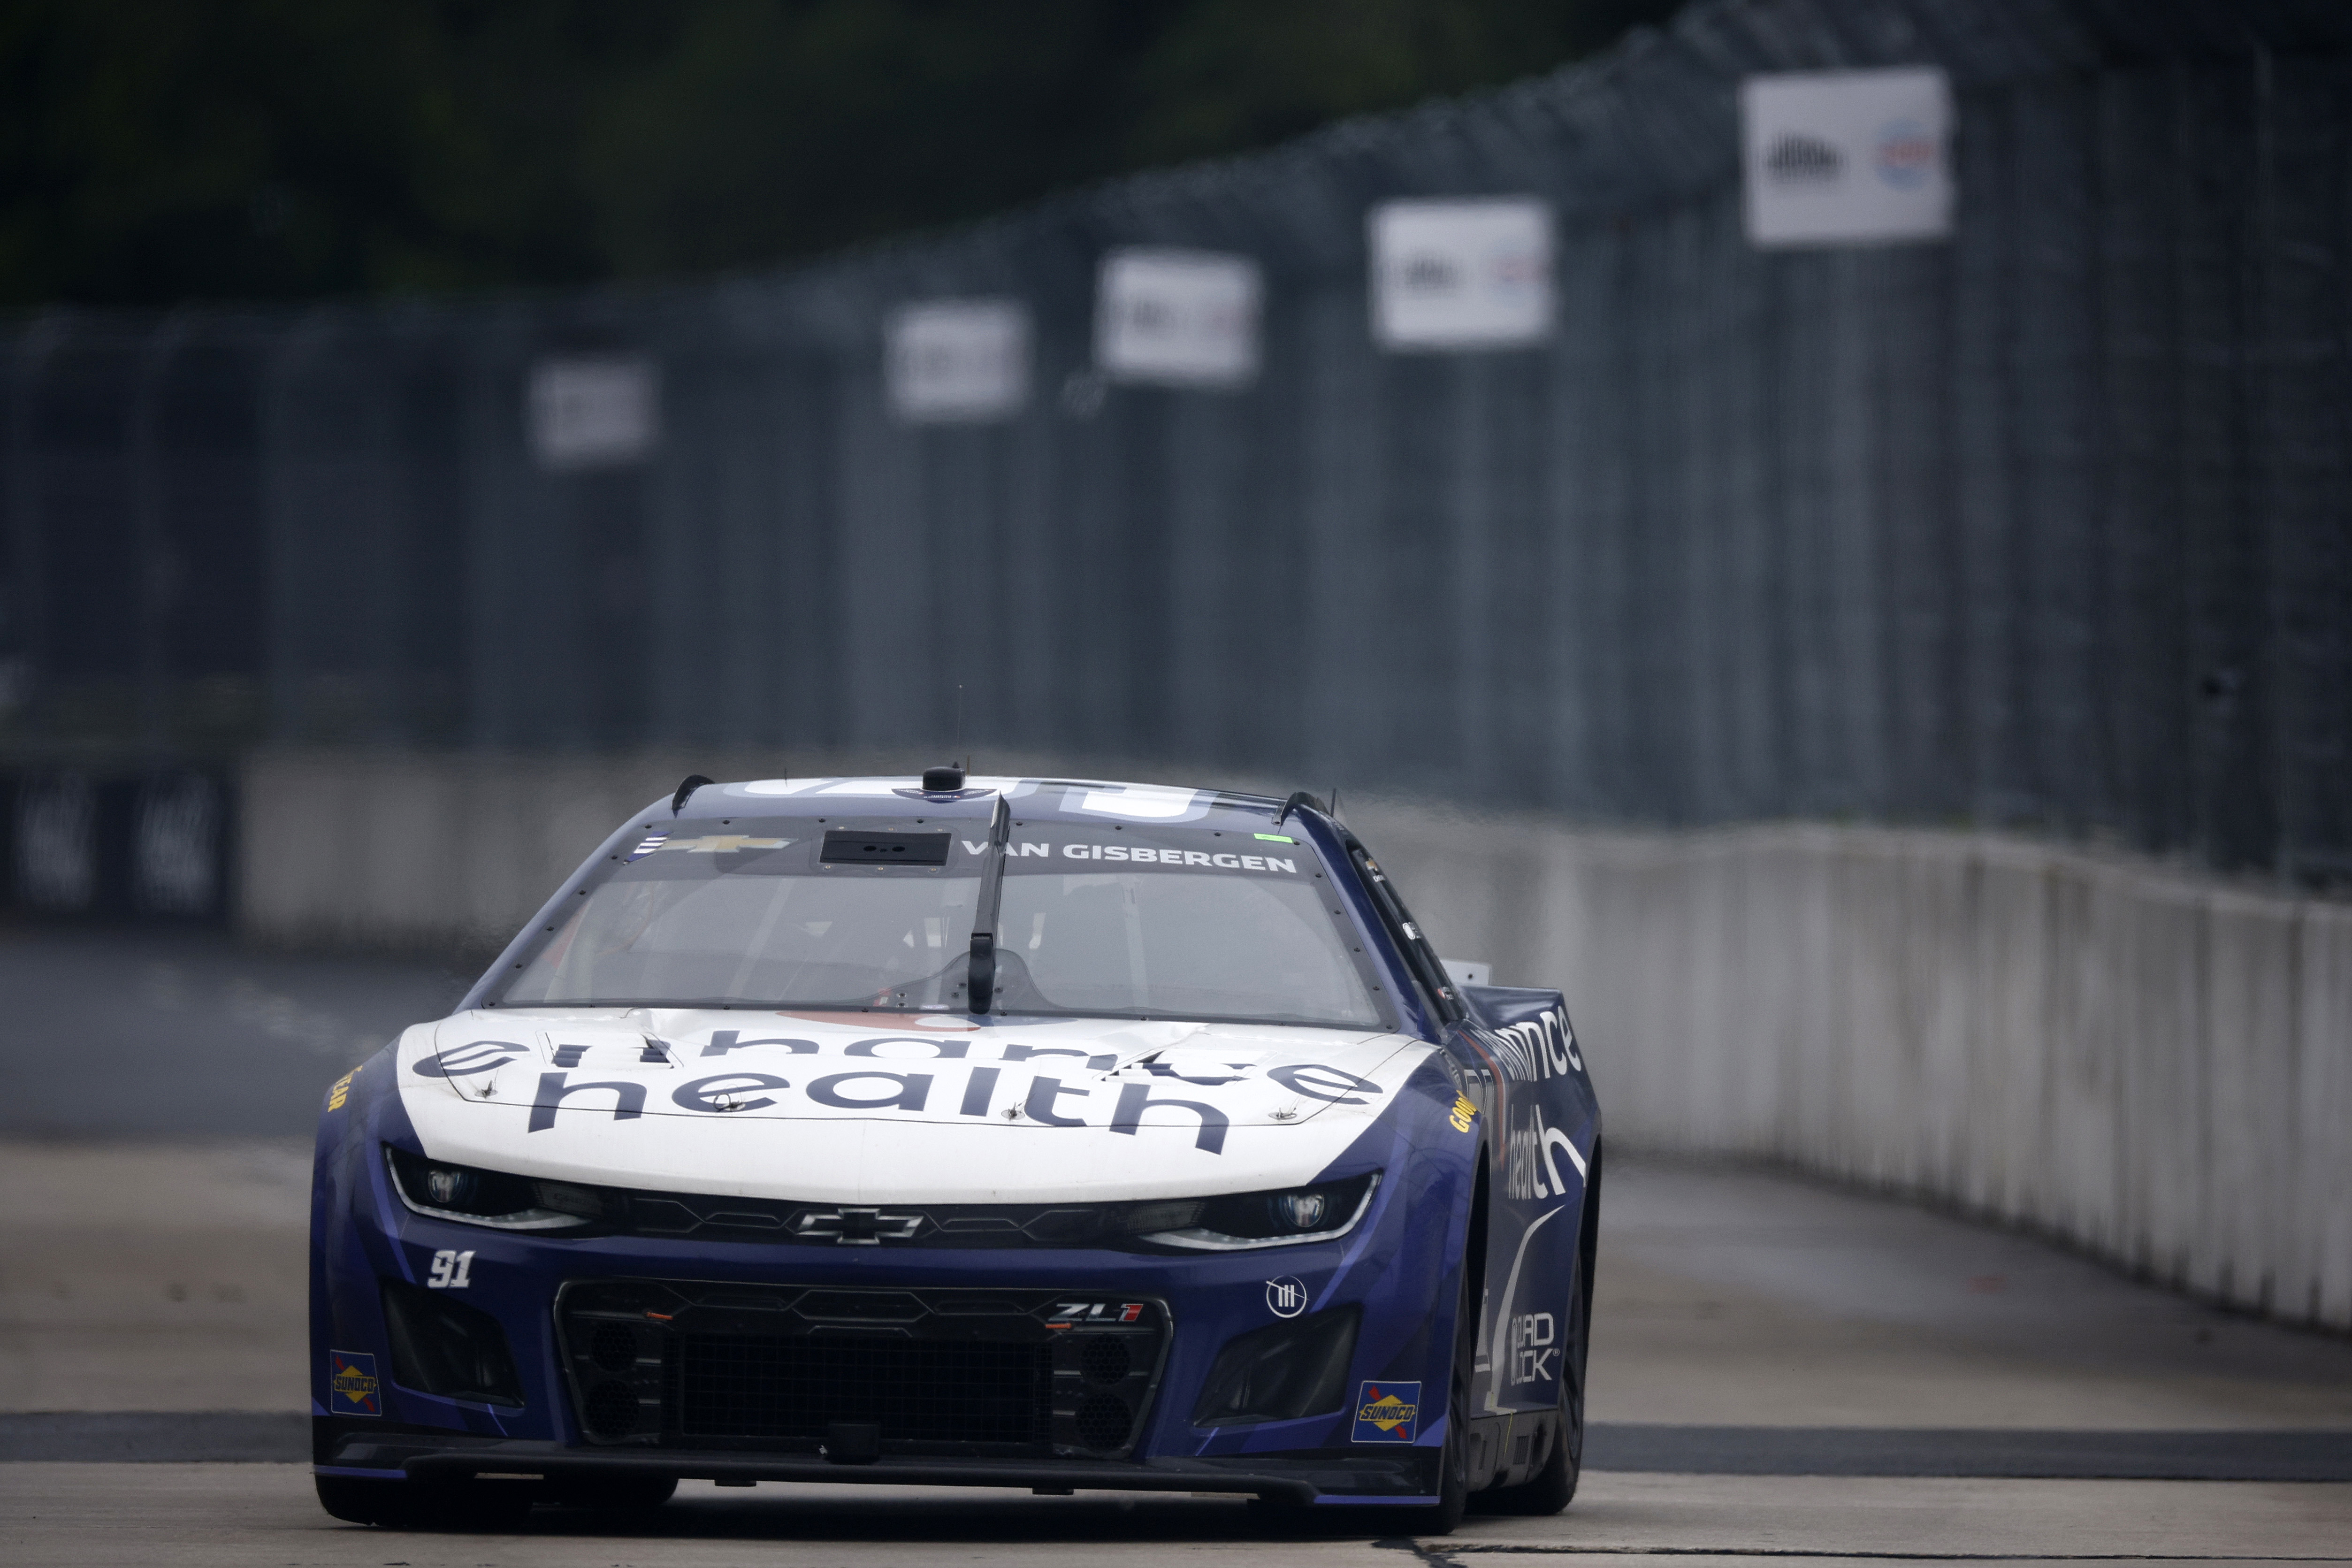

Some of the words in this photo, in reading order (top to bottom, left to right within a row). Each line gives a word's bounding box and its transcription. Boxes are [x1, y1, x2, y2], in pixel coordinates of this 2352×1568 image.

[1063, 844, 1297, 873] GISBERGEN
[527, 1066, 1230, 1156] health
[427, 1249, 476, 1288] 91
[1048, 1303, 1144, 1322] ZL1
[335, 1375, 375, 1393] SUNOCO
[1359, 1404, 1415, 1422] SUNOCO
